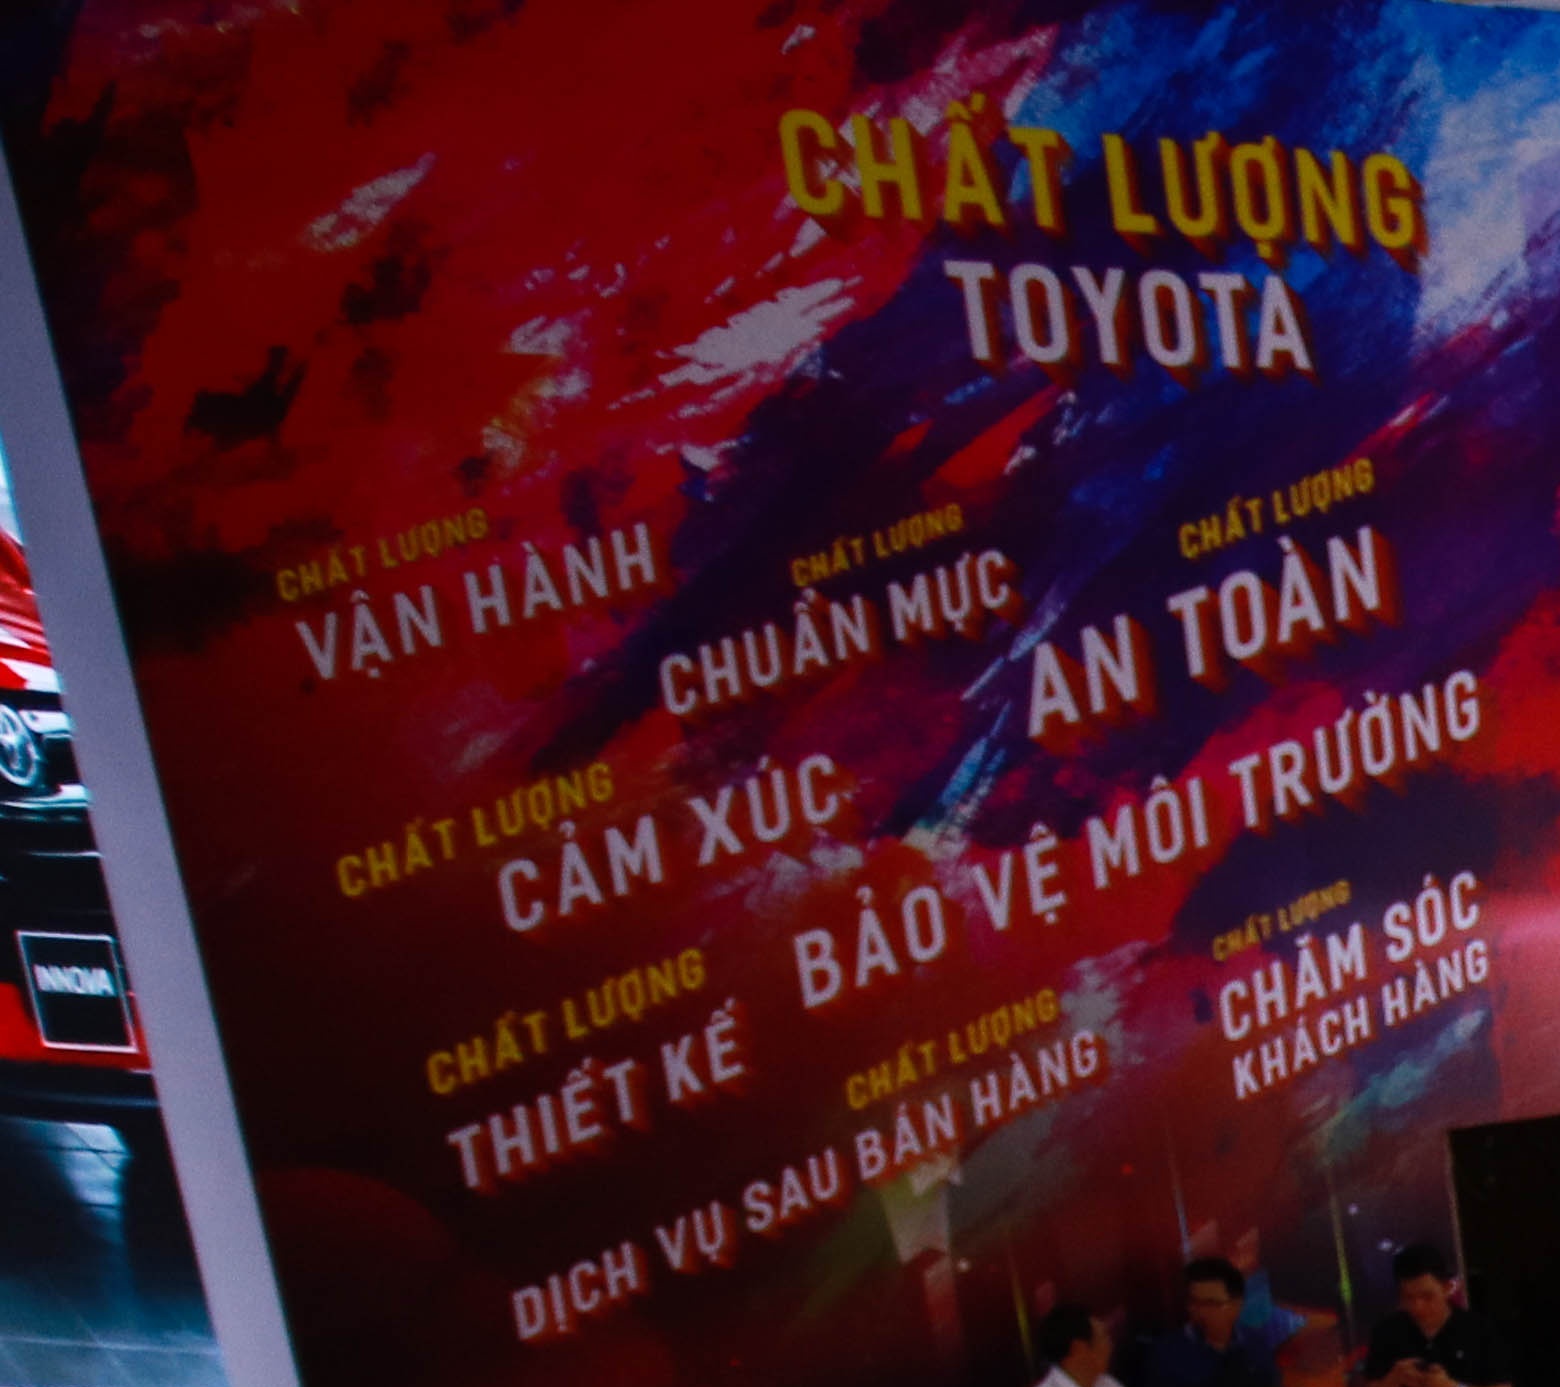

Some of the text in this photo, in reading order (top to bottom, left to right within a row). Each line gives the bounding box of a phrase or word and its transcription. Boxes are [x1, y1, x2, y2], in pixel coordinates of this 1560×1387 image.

[779, 94, 1418, 258] CHẤT LƯỢNG
[944, 259, 1313, 370] TOYOTA
[297, 522, 658, 680] VẬN HÀNH
[659, 550, 1012, 716] CHUẨN MỰC
[1028, 525, 1381, 737] AN TOÀN
[336, 762, 615, 898] CHẤT LƯỢNG
[499, 754, 841, 934] CẢM XÚC
[794, 670, 1481, 1008] BẢO VỆ MÔI TRƯỜNG
[426, 947, 706, 1095] CHẤT LƯỢNG
[1219, 871, 1481, 1041] CHĂM SÓC
[1232, 937, 1491, 1099] KHÁCH HÀNG
[447, 996, 747, 1190] THIẾT KẾ
[845, 988, 1060, 1111] CHẤT LƯỢNG
[511, 1029, 1099, 1341] DỊCH VỤ SAU BÁN HÀNG
